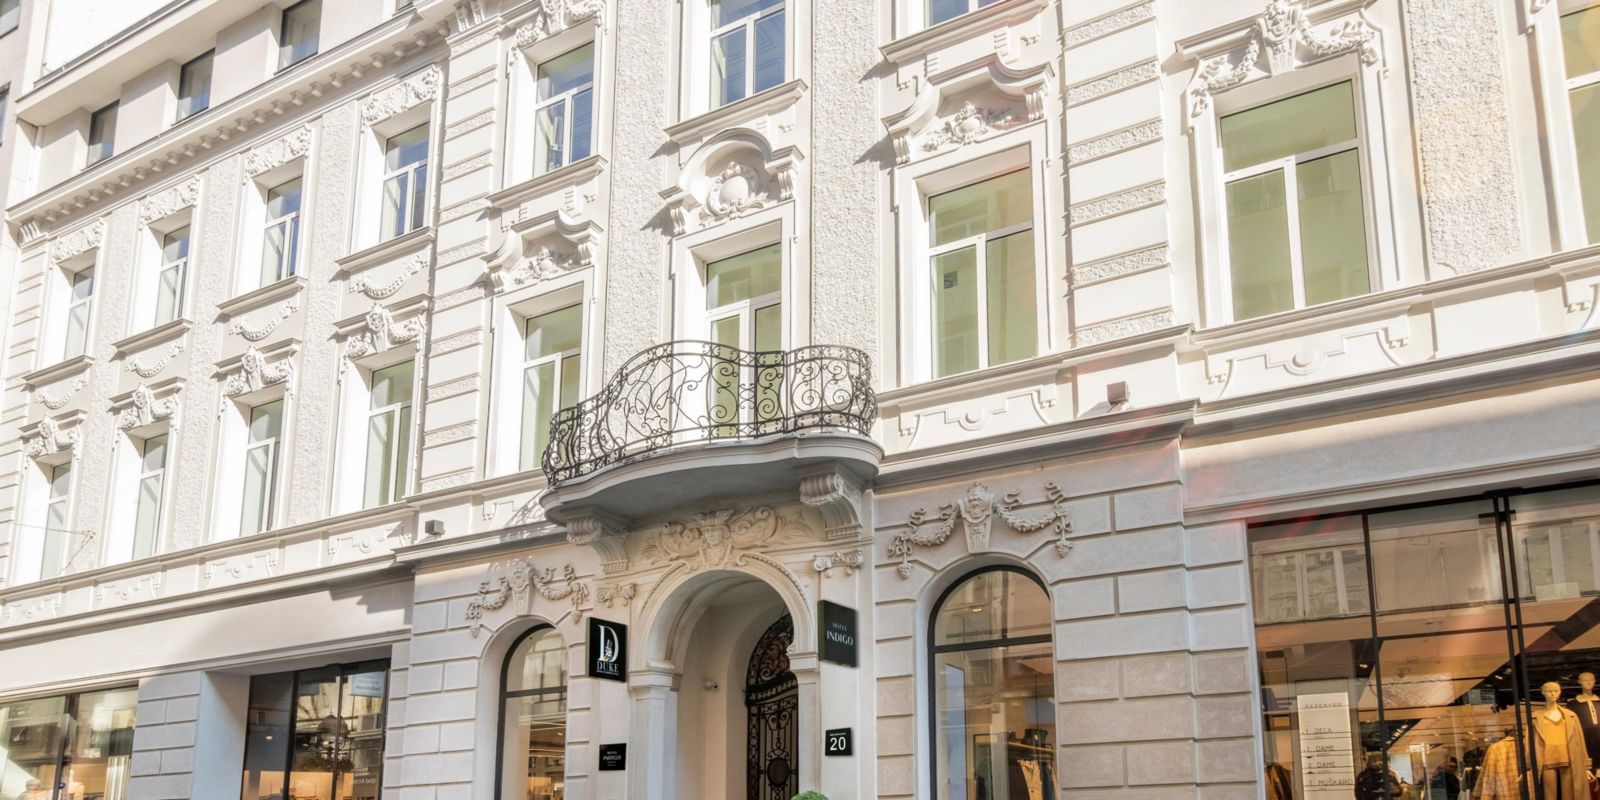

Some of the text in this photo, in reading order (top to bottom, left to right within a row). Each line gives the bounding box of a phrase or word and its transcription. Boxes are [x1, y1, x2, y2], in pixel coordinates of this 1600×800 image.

[826, 630, 854, 646] INDIGO
[597, 660, 619, 672] DUKE
[830, 736, 846, 751] 20
[1316, 761, 1336, 769] DAME
